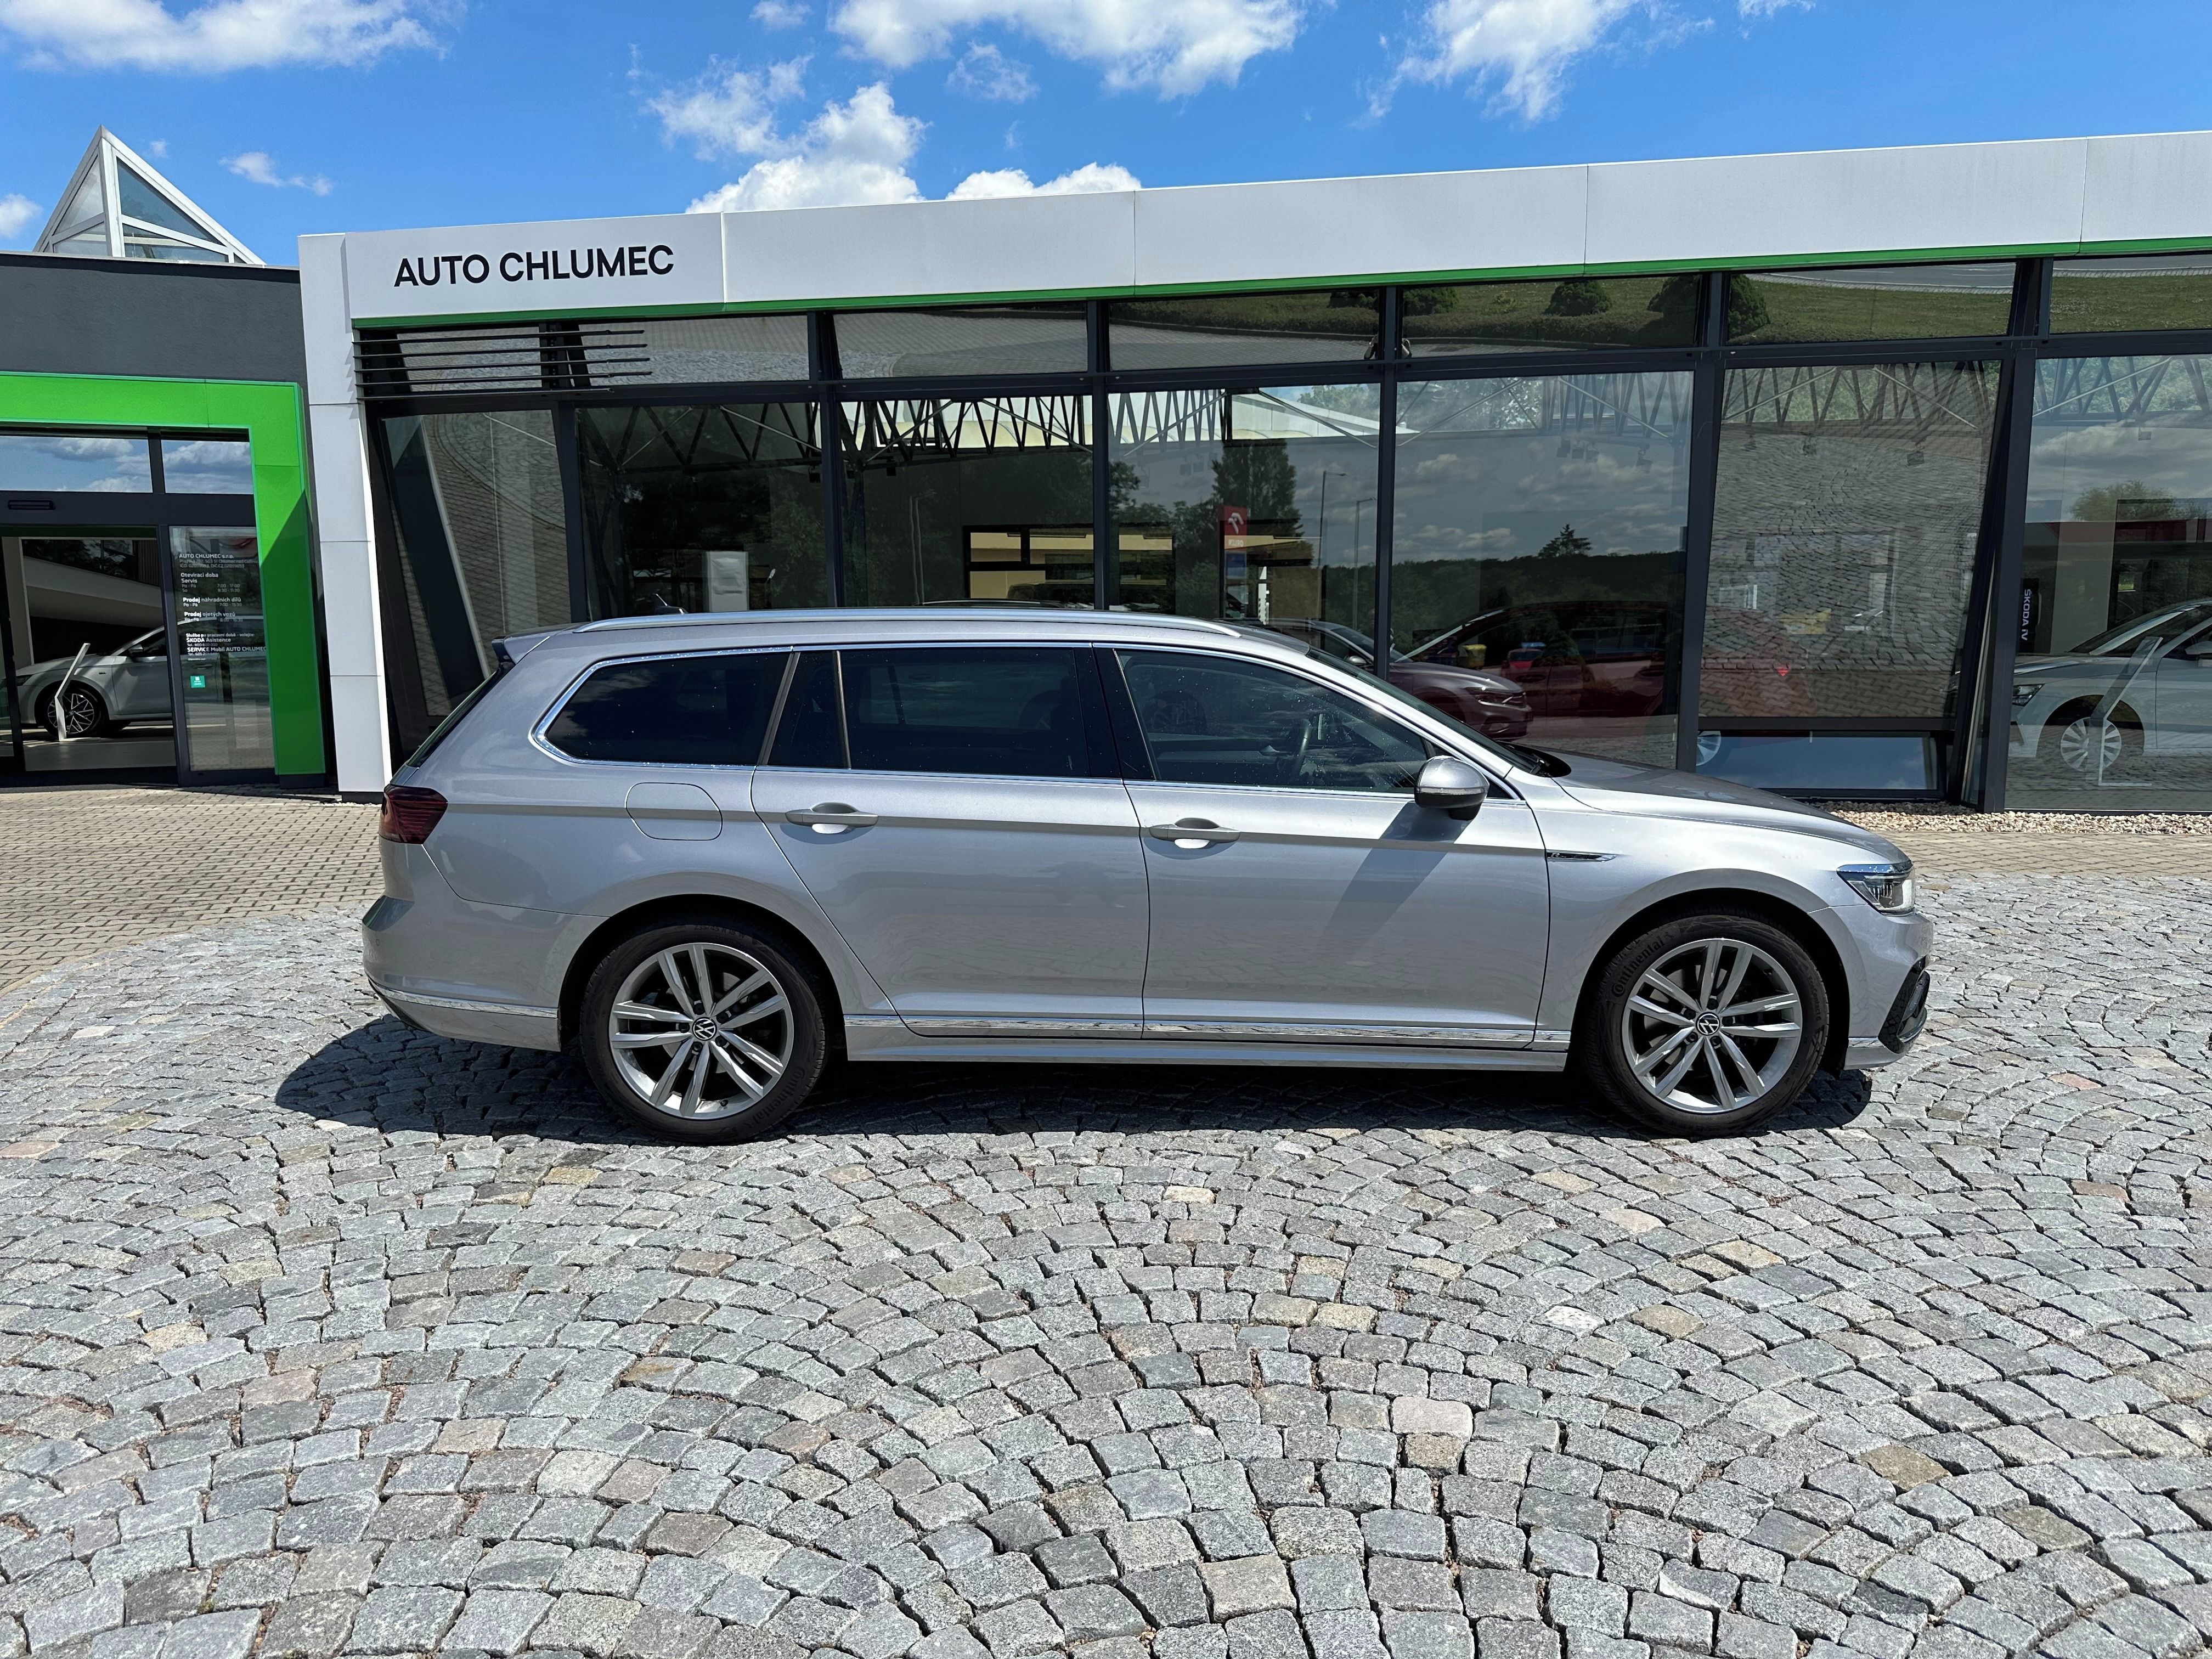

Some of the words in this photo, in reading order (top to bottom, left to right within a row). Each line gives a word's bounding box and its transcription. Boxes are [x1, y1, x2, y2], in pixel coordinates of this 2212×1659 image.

[394, 254, 489, 287] AUTO
[499, 245, 674, 281] CHLUMEC
[2022, 589, 2032, 626] ŠKODA
[1612, 935, 1664, 997] Continental
